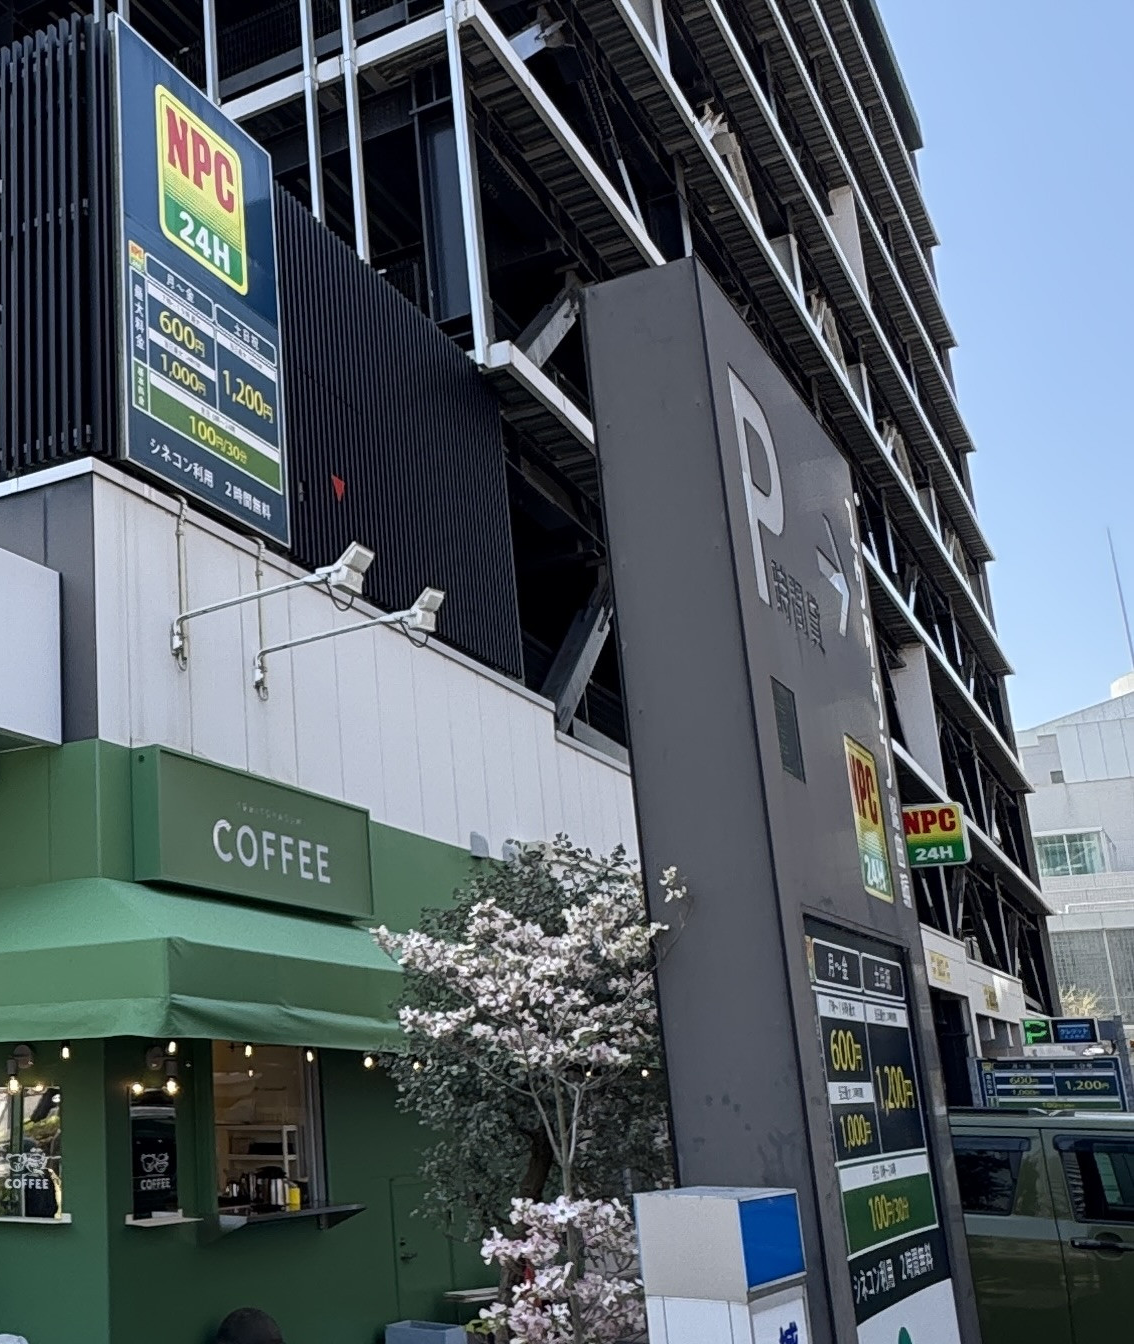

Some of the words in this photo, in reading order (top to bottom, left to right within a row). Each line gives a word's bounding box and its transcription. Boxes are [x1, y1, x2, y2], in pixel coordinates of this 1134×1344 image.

[166, 104, 234, 213] NPC
[179, 211, 230, 274] 24H
[159, 310, 206, 358] 600円
[234, 322, 260, 351] 土日祝
[160, 353, 206, 397] 1,000円
[222, 369, 273, 424] 1,200円
[150, 438, 214, 489] シネコン利用
[225, 481, 272, 521] 2時間無料
[727, 361, 784, 607] P
[850, 754, 879, 825] NPC
[903, 808, 956, 835] NPC
[213, 819, 331, 884] COFFEE
[916, 845, 954, 861] 24H
[830, 1029, 864, 1072] 600円
[875, 1065, 916, 1116] 1,200円
[1064, 1080, 1110, 1091] 1,200円
[840, 1114, 873, 1153] 1,000円
[5, 1178, 49, 1190] COFFEE
[140, 1177, 171, 1190] COFFEE
